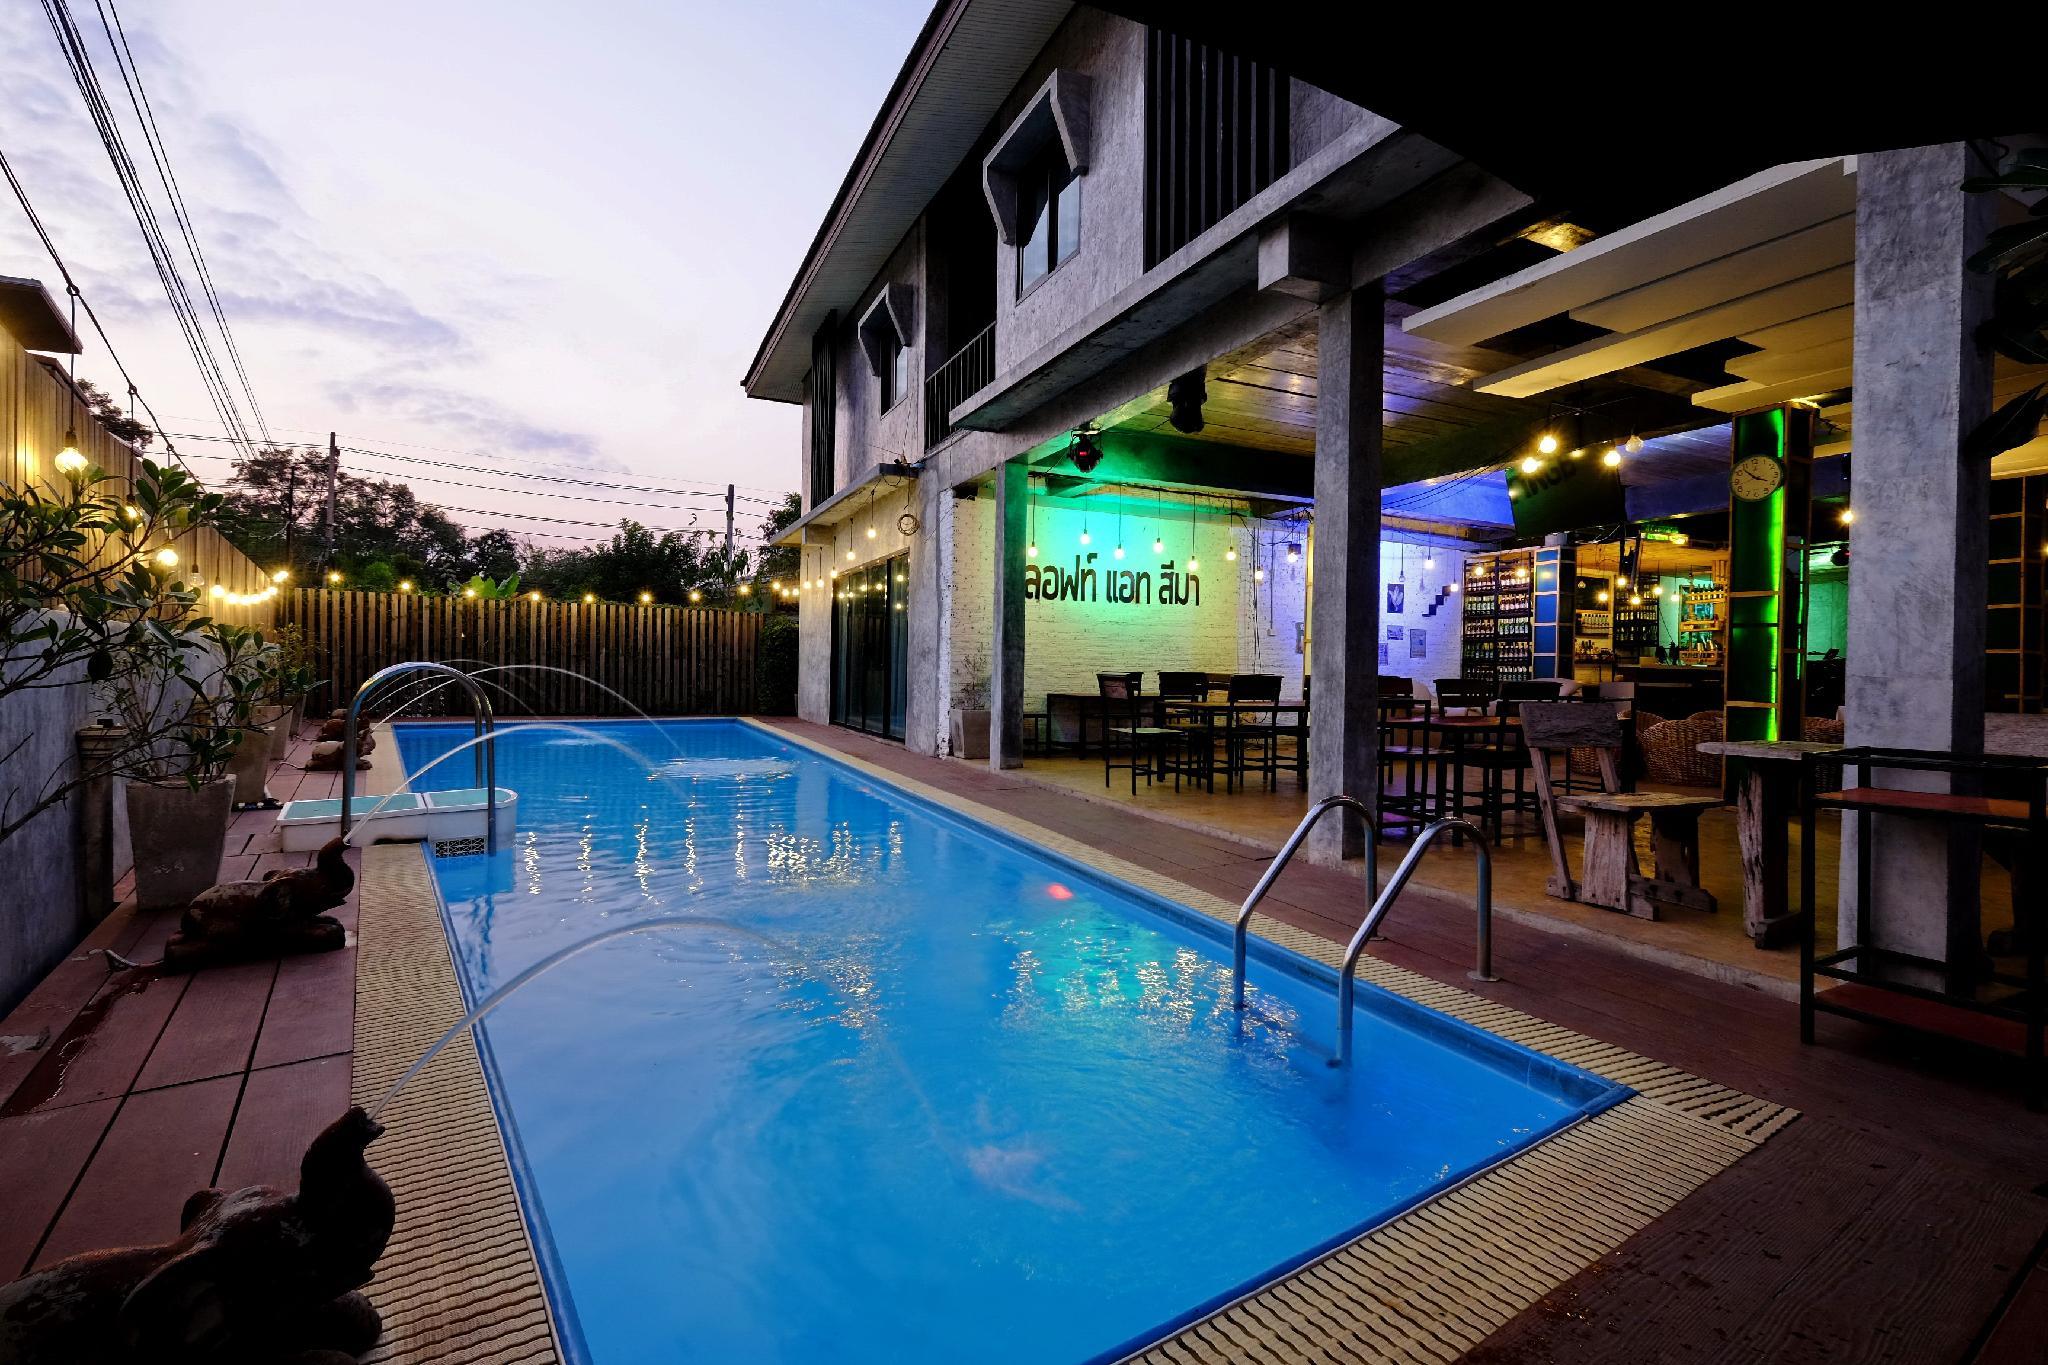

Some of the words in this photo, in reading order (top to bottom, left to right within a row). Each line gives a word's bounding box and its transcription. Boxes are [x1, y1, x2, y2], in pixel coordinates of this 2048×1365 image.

[1024, 552, 1098, 602] ลอฟท์
[1106, 570, 1151, 604] แอท
[1158, 559, 1200, 606] สีมา
